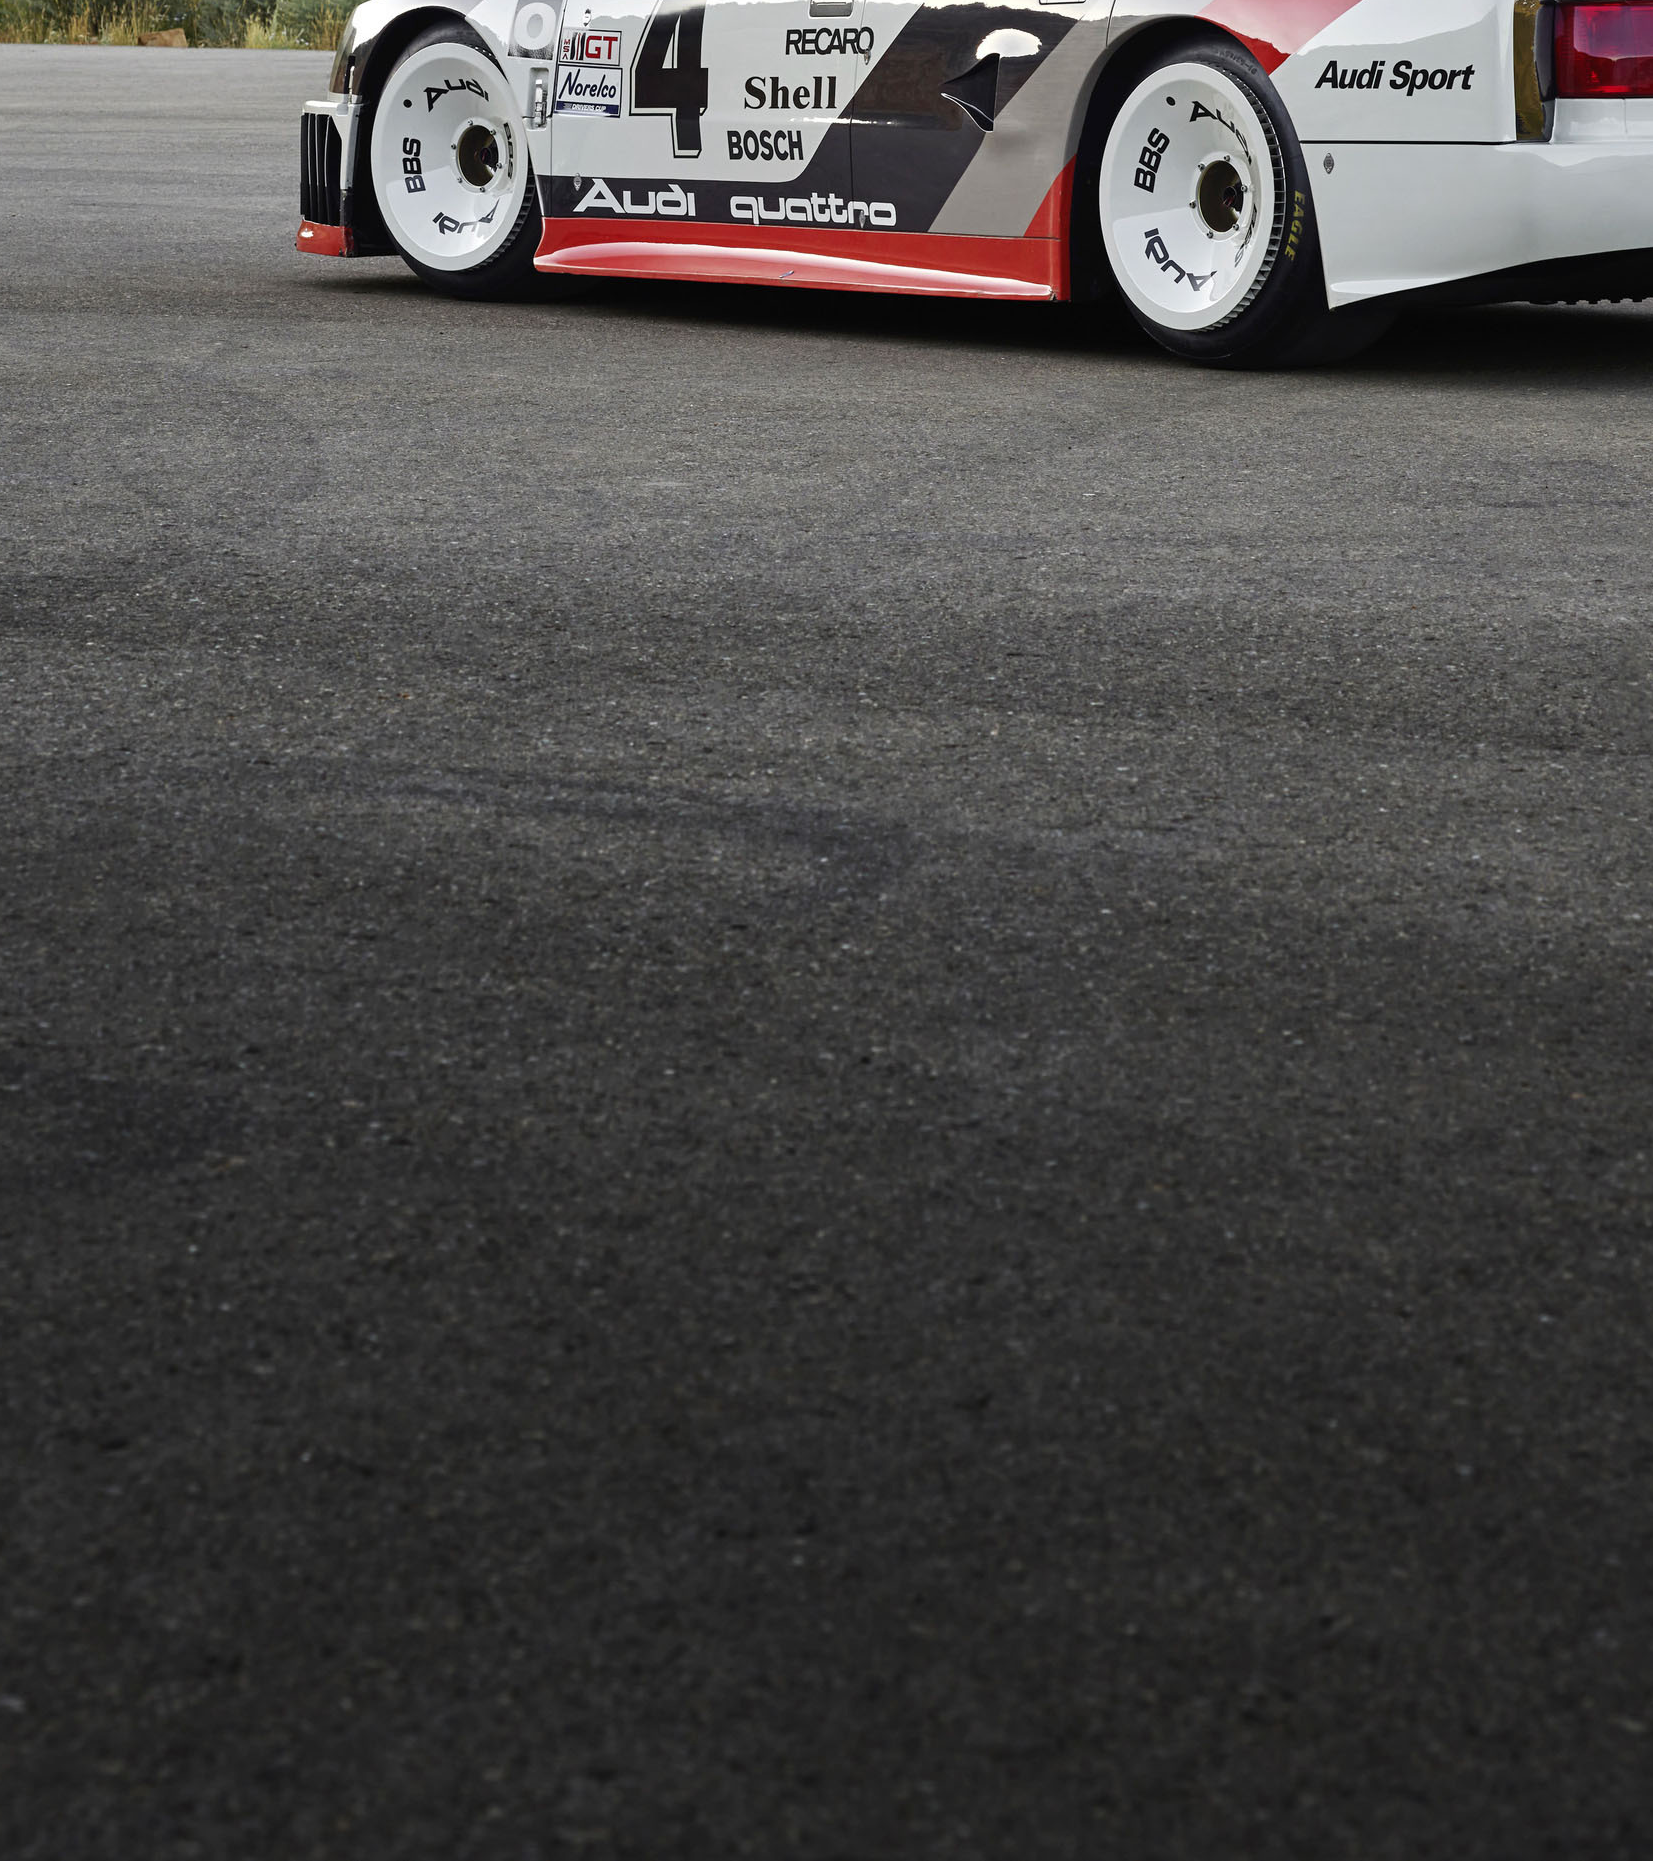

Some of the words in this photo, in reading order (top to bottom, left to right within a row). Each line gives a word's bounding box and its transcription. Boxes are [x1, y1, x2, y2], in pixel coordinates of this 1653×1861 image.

[786, 26, 874, 55] RECARO
[423, 78, 490, 113] Audi
[558, 68, 617, 100] Norelco
[744, 76, 837, 109] Shell
[1314, 60, 1386, 89] Audi
[1389, 60, 1475, 97] Sport
[727, 129, 804, 161] BOSCH
[1134, 127, 1170, 194] BBS
[402, 137, 427, 193] BBS
[572, 178, 696, 217] Audi
[730, 192, 896, 226] quattro
[1284, 190, 1306, 261] EAGLE
[1144, 228, 1218, 292] Audi
